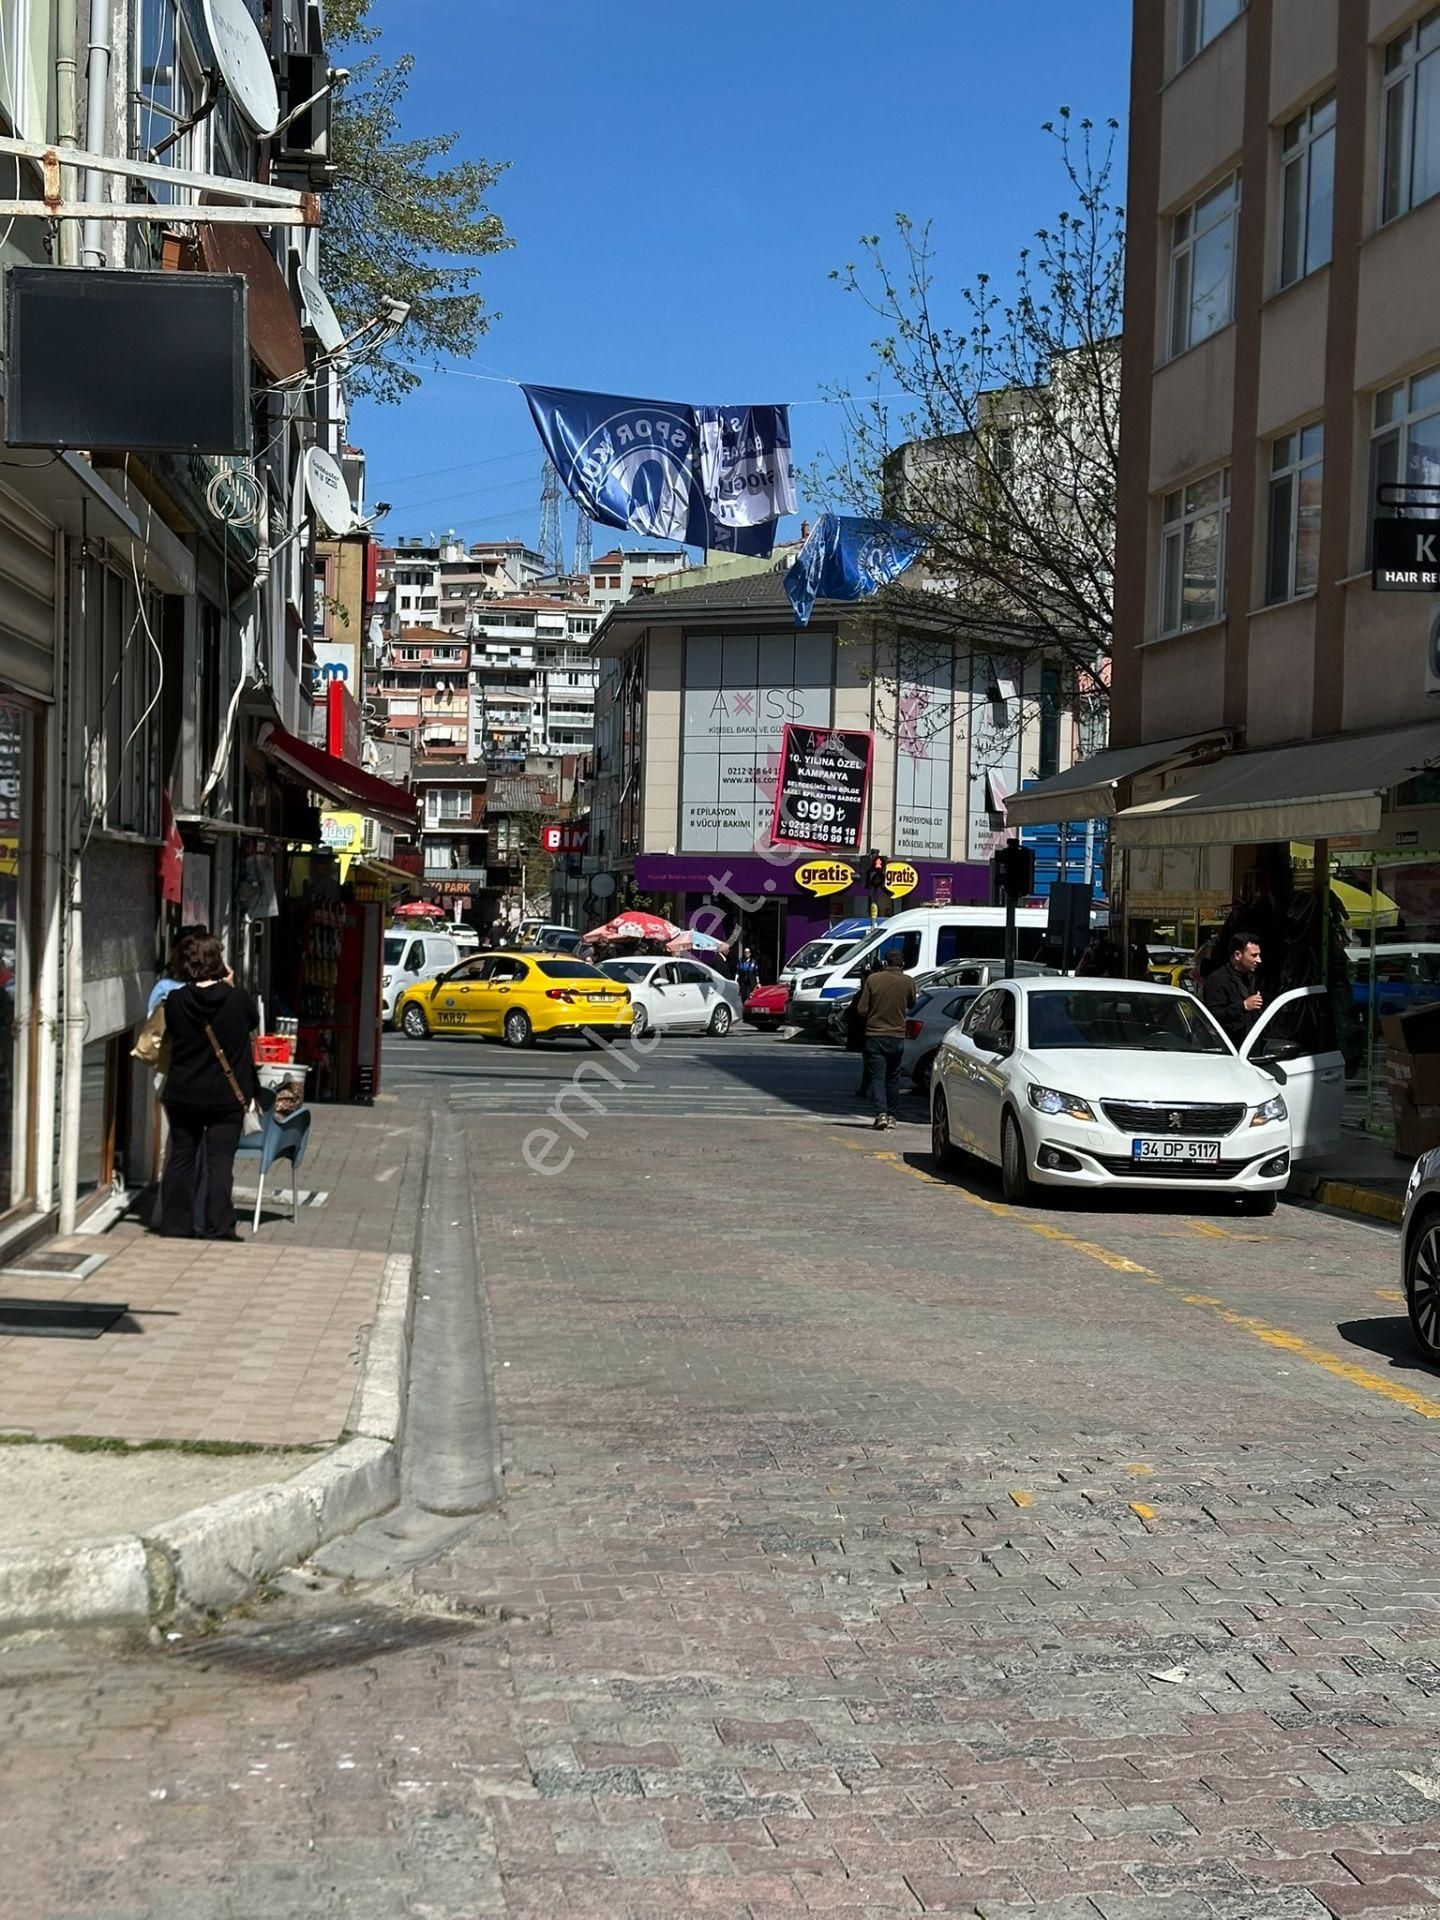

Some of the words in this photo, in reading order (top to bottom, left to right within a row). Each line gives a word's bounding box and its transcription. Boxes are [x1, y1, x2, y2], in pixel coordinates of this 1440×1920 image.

[1385, 571, 1418, 583] HAIR
[1422, 572, 1440, 583] RE
[709, 688, 806, 719] AXISS
[836, 757, 862, 769] ÖZEL
[727, 767, 746, 775] 0212
[762, 767, 772, 775] 64
[797, 767, 849, 781] KAMPANYA
[696, 807, 736, 816] EPİLASYON
[696, 818, 722, 828] VÜCUT
[788, 820, 811, 831] 0212
[812, 823, 829, 833] 218
[831, 826, 842, 835] 64
[845, 827, 856, 836] 18
[788, 829, 810, 839] 0553
[830, 834, 842, 843] 99
[844, 836, 855, 845] 18
[801, 864, 849, 885] gratis
[886, 866, 914, 886] gratis
[444, 882, 471, 893] PARK
[1142, 1142, 1158, 1156] 34
[1163, 1142, 1184, 1157] DP
[1188, 1143, 1218, 1158] 5117
